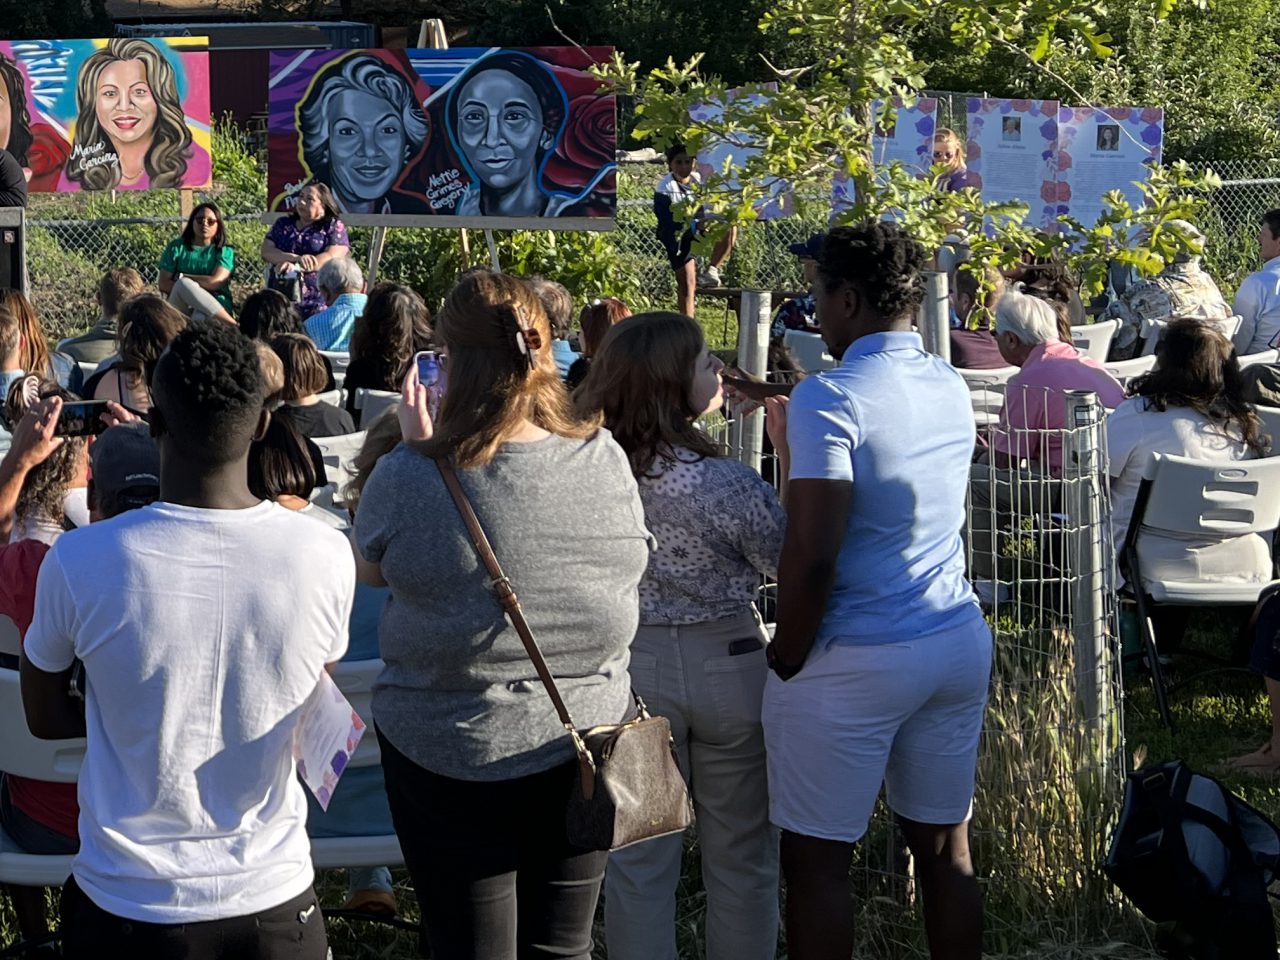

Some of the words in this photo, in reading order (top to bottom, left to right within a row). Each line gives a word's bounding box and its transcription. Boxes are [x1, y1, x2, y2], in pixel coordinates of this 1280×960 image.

[70, 140, 106, 160] Maria
[429, 169, 459, 189] Nettie
[430, 182, 470, 209] Gregory
